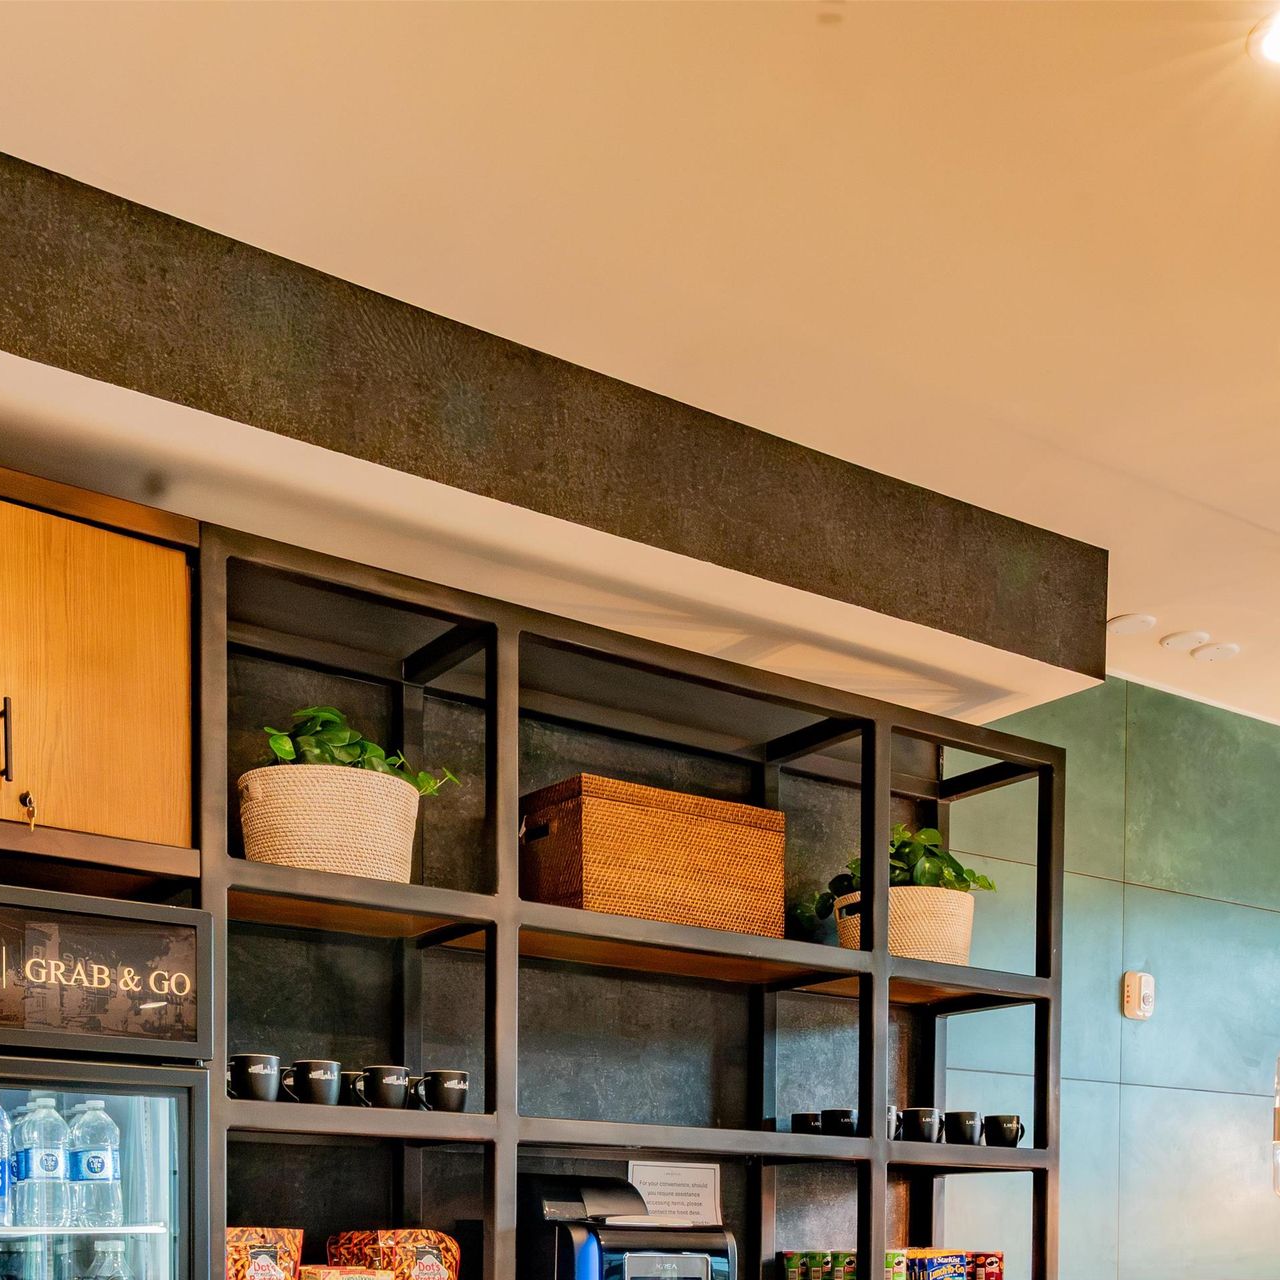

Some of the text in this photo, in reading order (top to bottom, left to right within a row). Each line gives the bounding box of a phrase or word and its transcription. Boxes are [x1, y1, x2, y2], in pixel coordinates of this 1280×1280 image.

[25, 957, 110, 988] GRAB
[119, 969, 140, 992] &
[149, 971, 191, 996] GO
[253, 1261, 276, 1273] Dot's
[418, 1261, 441, 1273] Dot's
[930, 1264, 965, 1280] Lunch-to-Go
